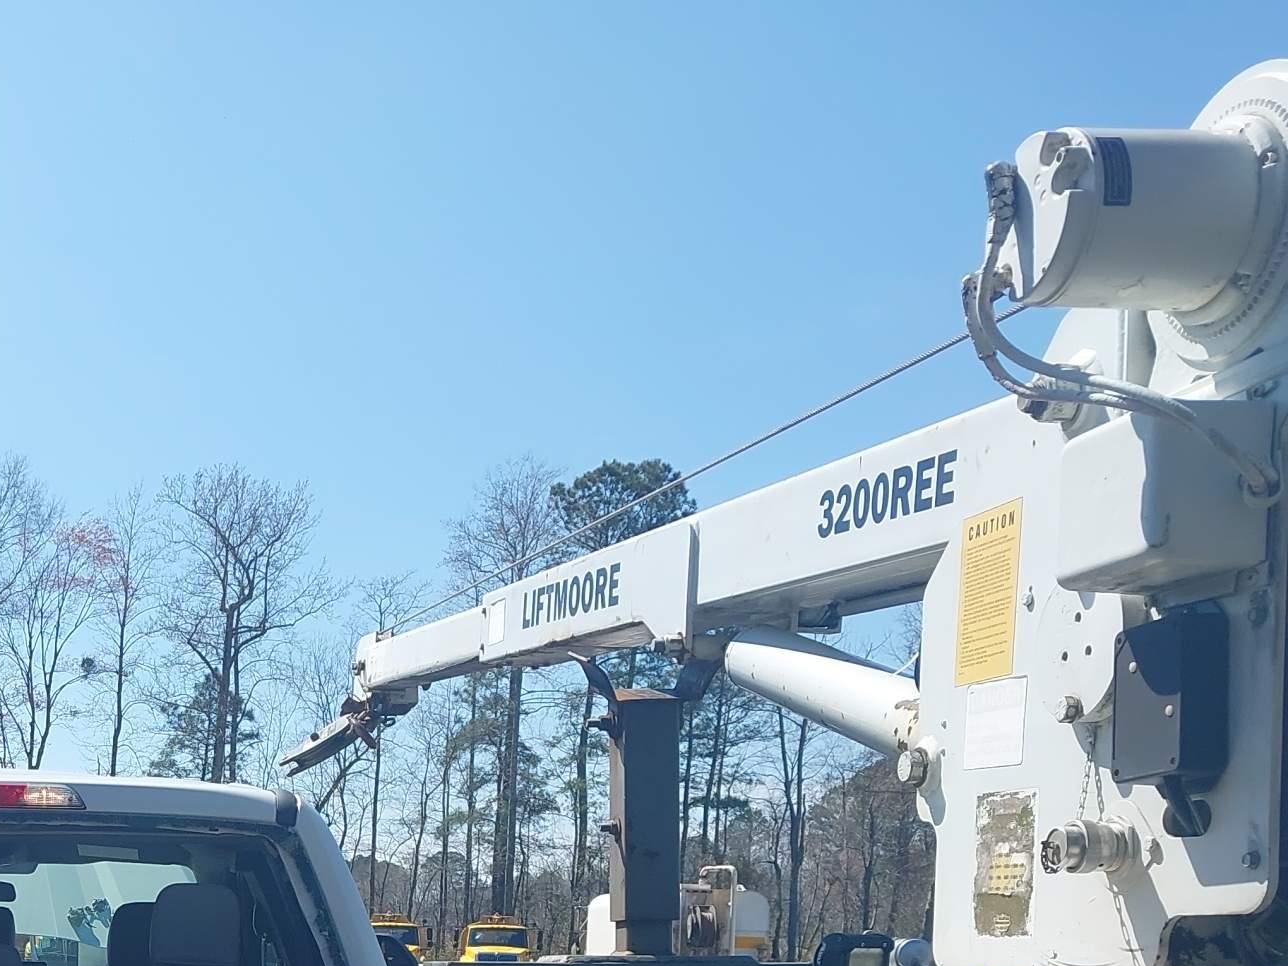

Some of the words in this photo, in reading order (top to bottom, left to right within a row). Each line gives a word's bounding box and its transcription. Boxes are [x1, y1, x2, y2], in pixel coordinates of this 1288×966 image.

[817, 449, 959, 539] 3200REE
[967, 509, 1017, 541] CAUTION
[522, 563, 622, 630] LIFTMOORE
